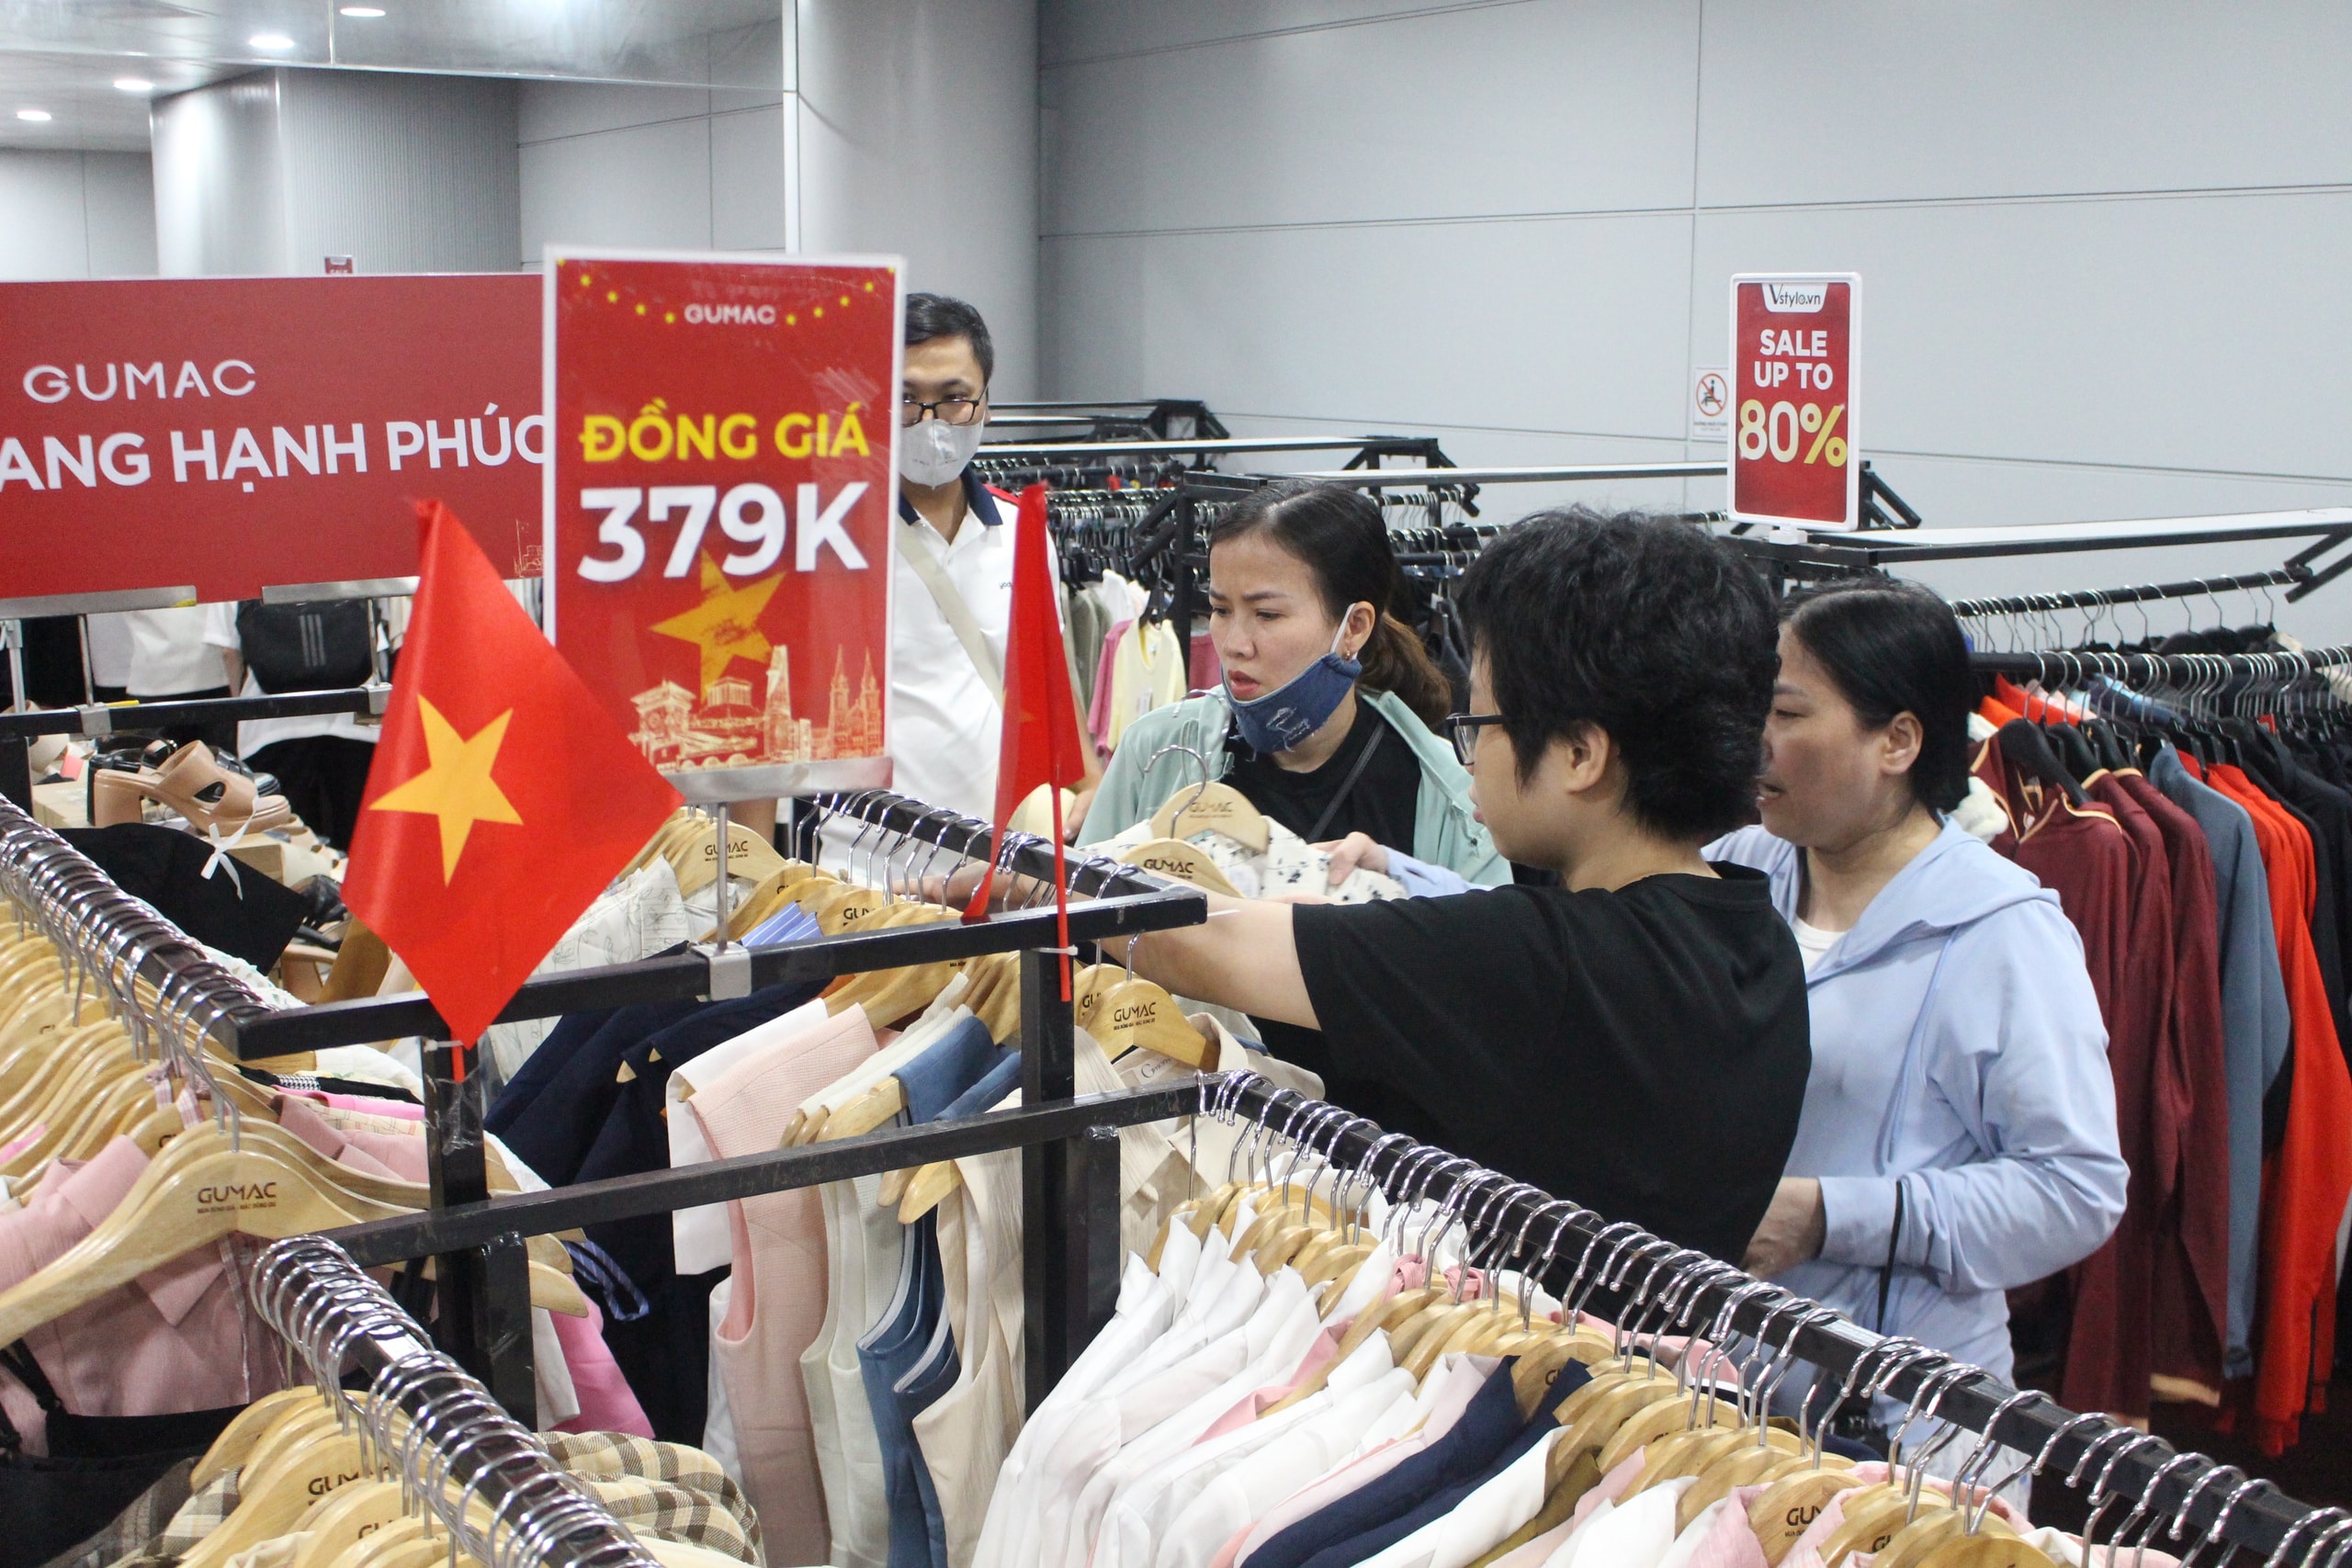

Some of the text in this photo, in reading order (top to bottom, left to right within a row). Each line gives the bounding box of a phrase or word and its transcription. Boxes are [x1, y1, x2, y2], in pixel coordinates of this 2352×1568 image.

[684, 304, 777, 325] GUMAC
[1759, 329, 1827, 356] SALE
[23, 359, 255, 403] GUMAC
[1754, 361, 1834, 390] UP TO
[579, 398, 871, 462] ĐỒNG GIÁ
[1738, 399, 1848, 467] 80%
[171, 423, 368, 493] HẠNH
[577, 482, 871, 583] 379K
[1143, 859, 1194, 874] GUMAC
[1114, 1001, 1156, 1022] GUMAC
[198, 1181, 277, 1203] GUMAC
